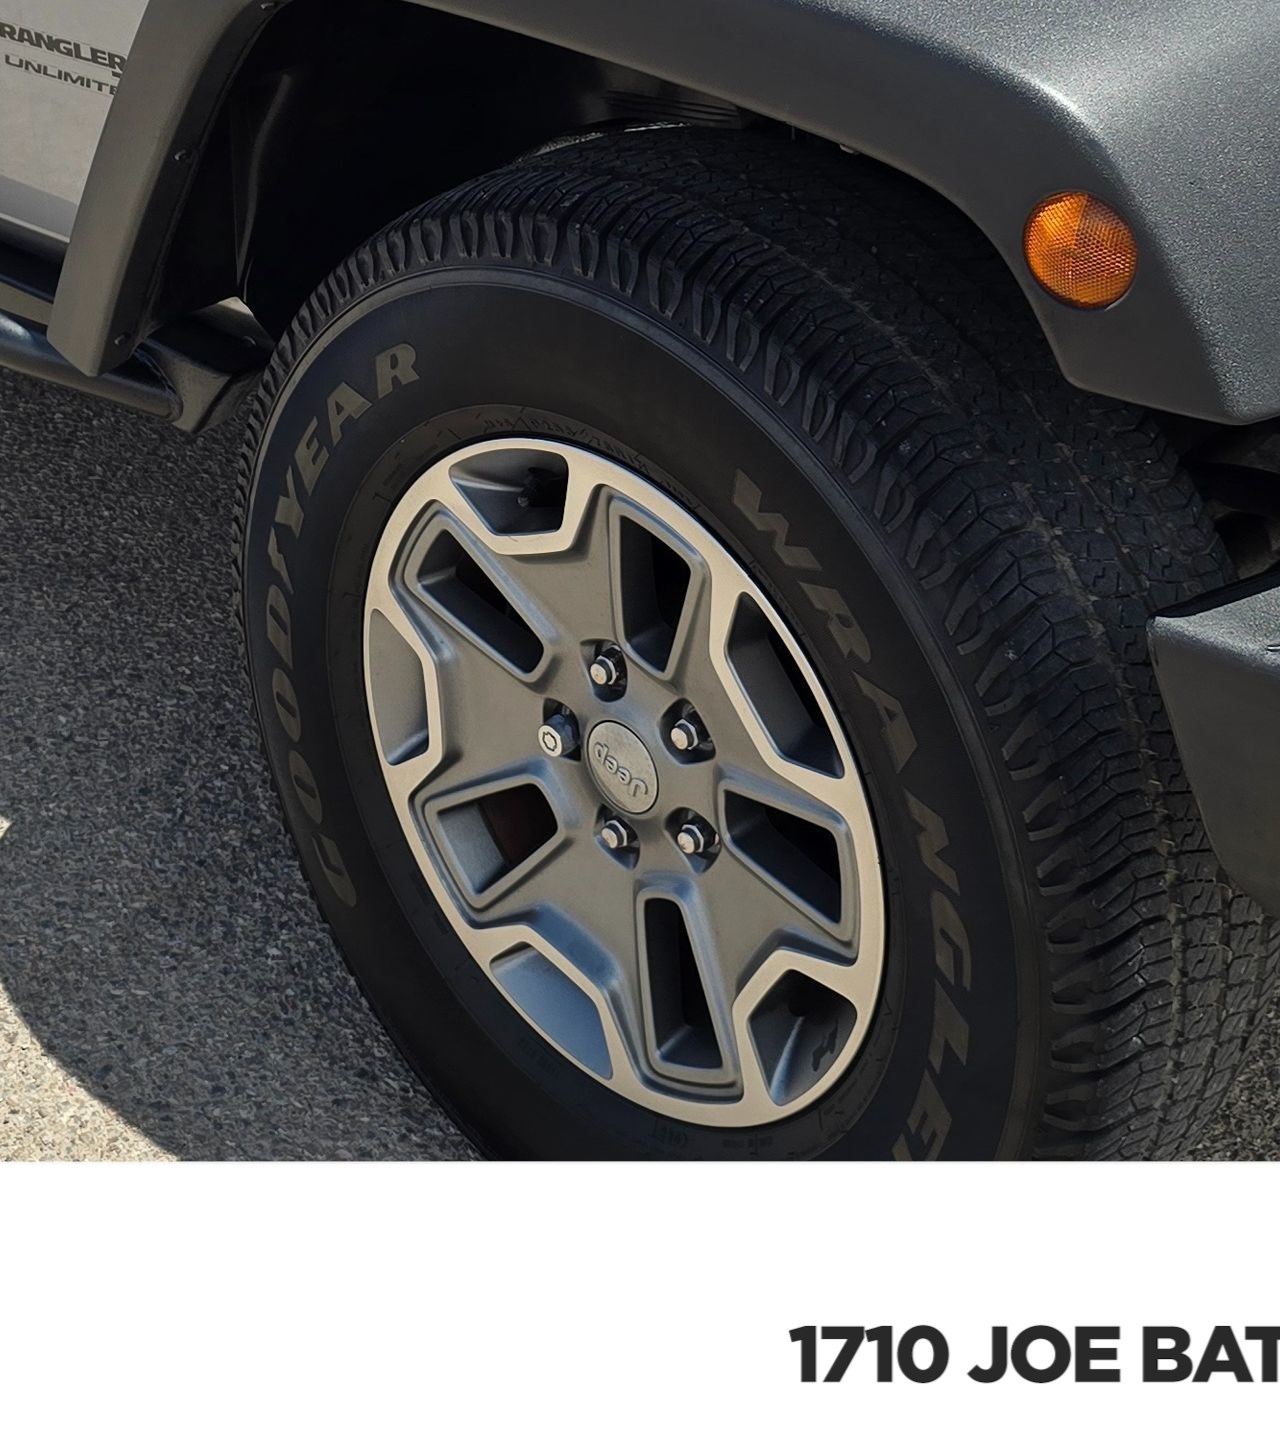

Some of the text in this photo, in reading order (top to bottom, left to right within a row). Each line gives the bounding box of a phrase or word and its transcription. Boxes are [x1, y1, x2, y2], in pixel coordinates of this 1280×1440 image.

[4, 54, 121, 96] UNLIMITE
[265, 342, 422, 909] GOODYEAR
[594, 741, 649, 798] Jeep
[733, 468, 972, 1162] WRANGLE
